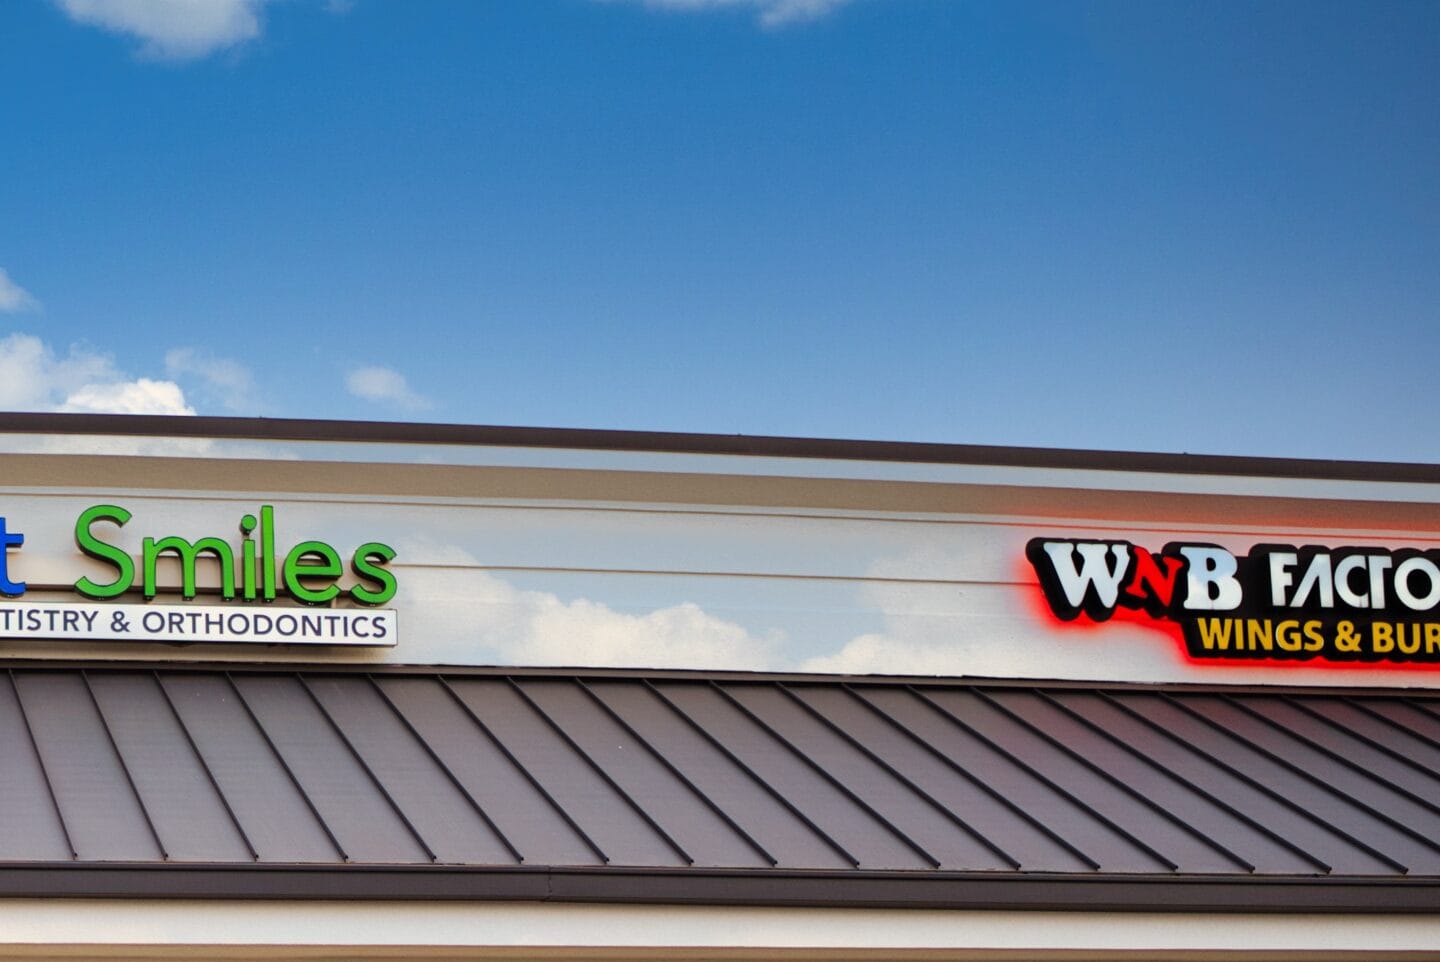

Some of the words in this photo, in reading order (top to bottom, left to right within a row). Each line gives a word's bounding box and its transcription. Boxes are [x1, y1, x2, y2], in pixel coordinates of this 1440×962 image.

[74, 504, 397, 605] Smiles
[110, 610, 131, 633] &
[142, 610, 387, 639] ORTHODONTICS
[1197, 617, 1325, 652] WINGS
[1335, 619, 1362, 652] &
